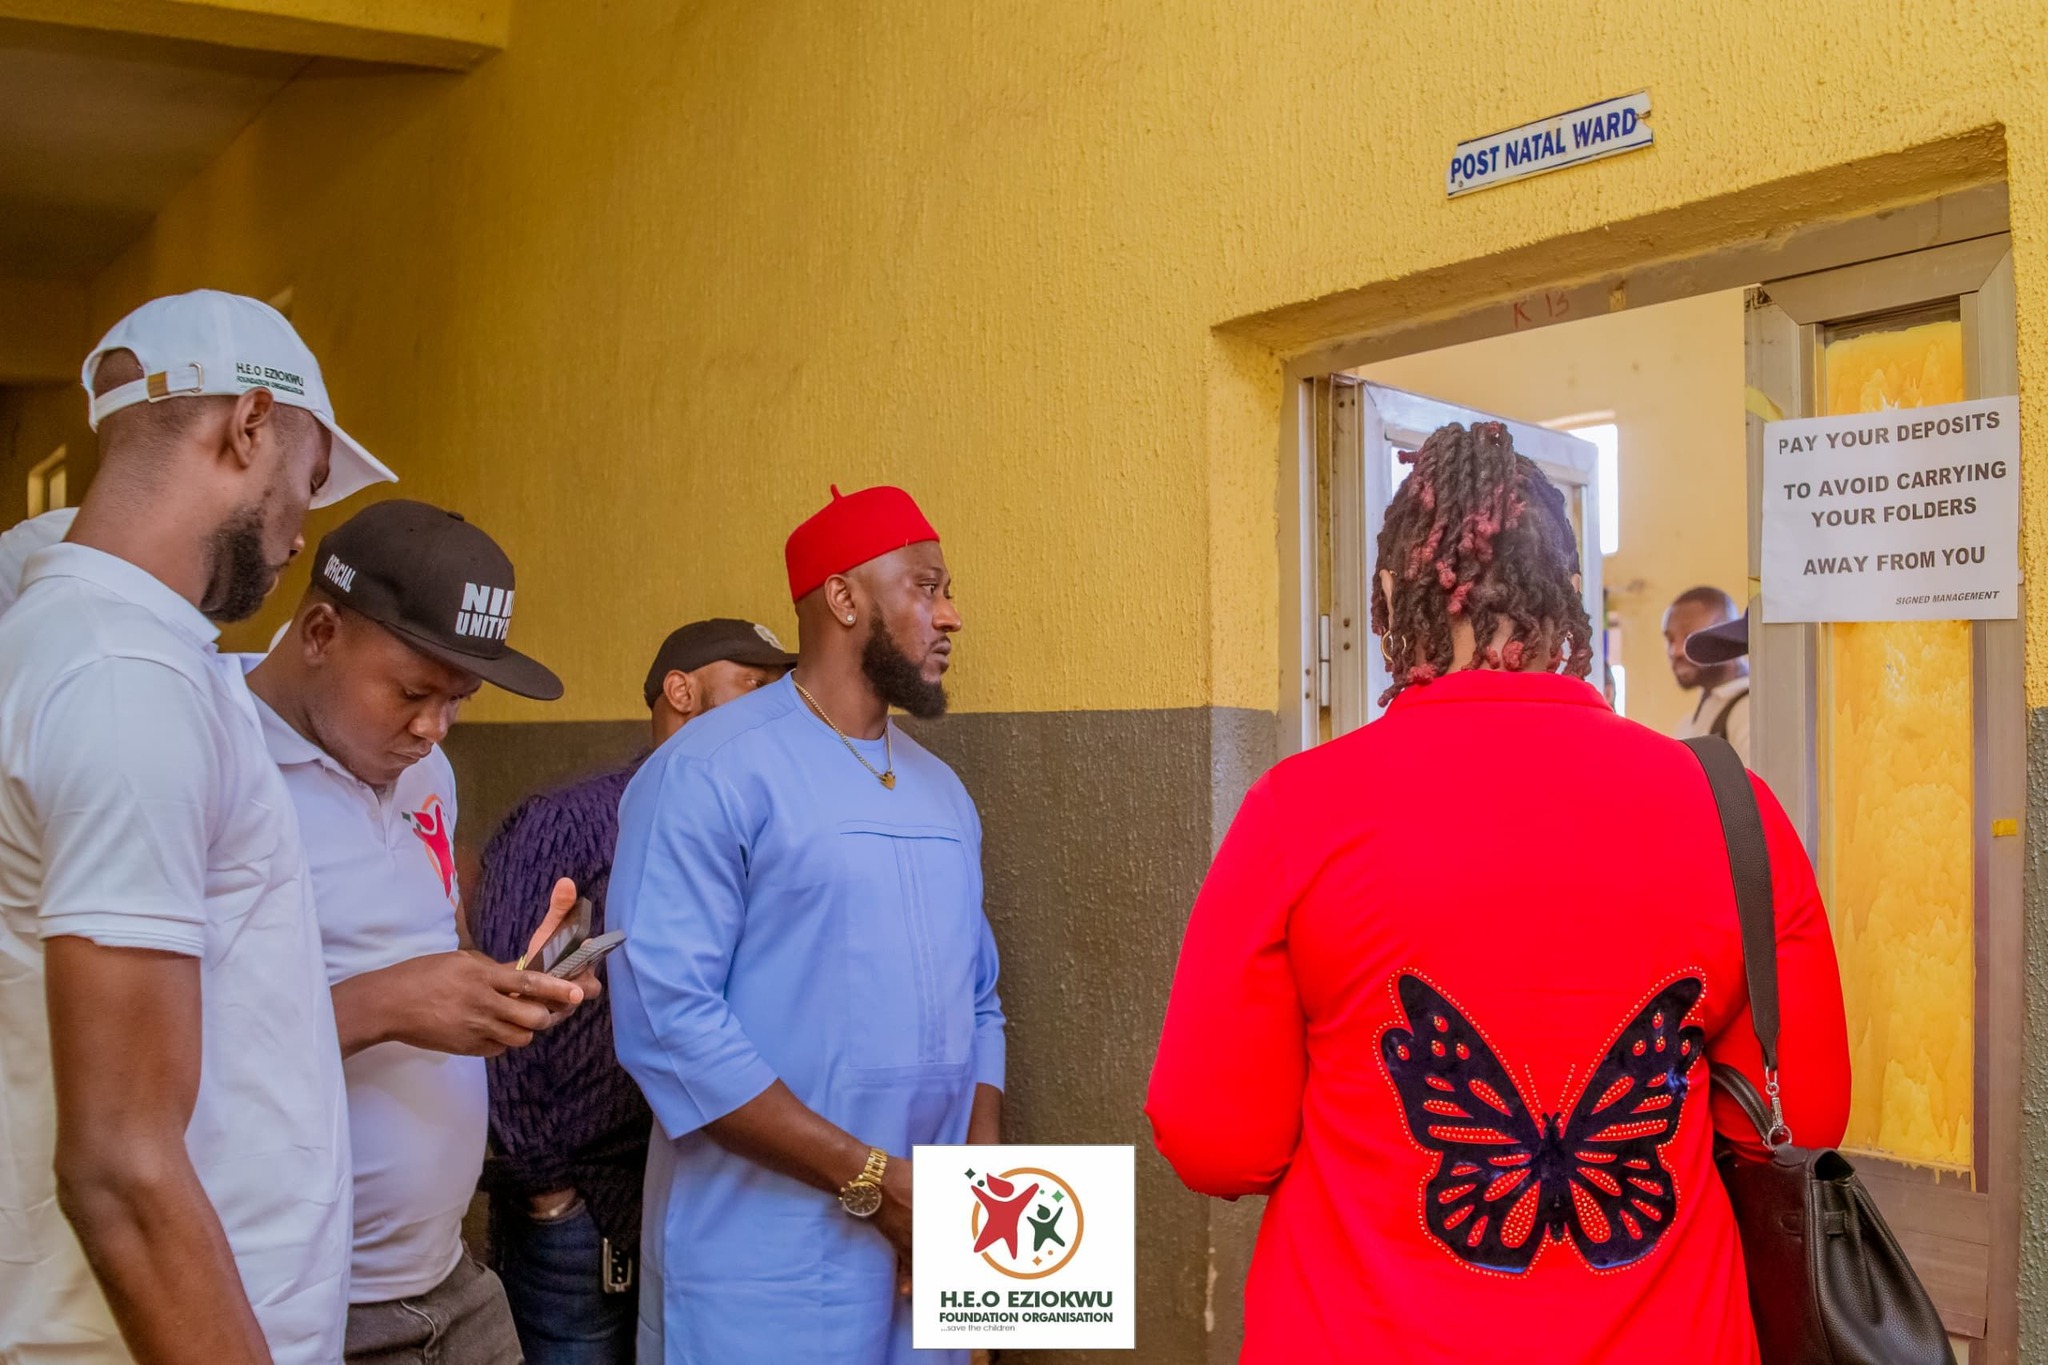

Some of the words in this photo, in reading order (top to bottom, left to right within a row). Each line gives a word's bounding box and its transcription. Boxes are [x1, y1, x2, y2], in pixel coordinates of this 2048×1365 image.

[1450, 145, 1500, 183] POST
[1505, 127, 1566, 169] NATAL
[1572, 107, 1637, 149] WARD
[264, 367, 304, 387] EZIOKWU
[1778, 434, 1818, 455] PAY
[1826, 427, 1889, 450] YOUR
[1897, 411, 2000, 443] DEPOSITS
[1784, 482, 1811, 500] TO
[1818, 475, 1889, 497] AVOID
[1896, 460, 2007, 490] CARRYING
[1811, 508, 1876, 528] YOUR
[1883, 496, 1977, 523] FOLDERS
[324, 554, 356, 593] OFFICIAL
[1803, 556, 1868, 576] AWAY
[1876, 551, 1935, 572] FROM
[1942, 545, 1985, 567] YOU
[1896, 594, 1930, 606] SIGNED
[1932, 590, 2000, 603] MANAGEMENT
